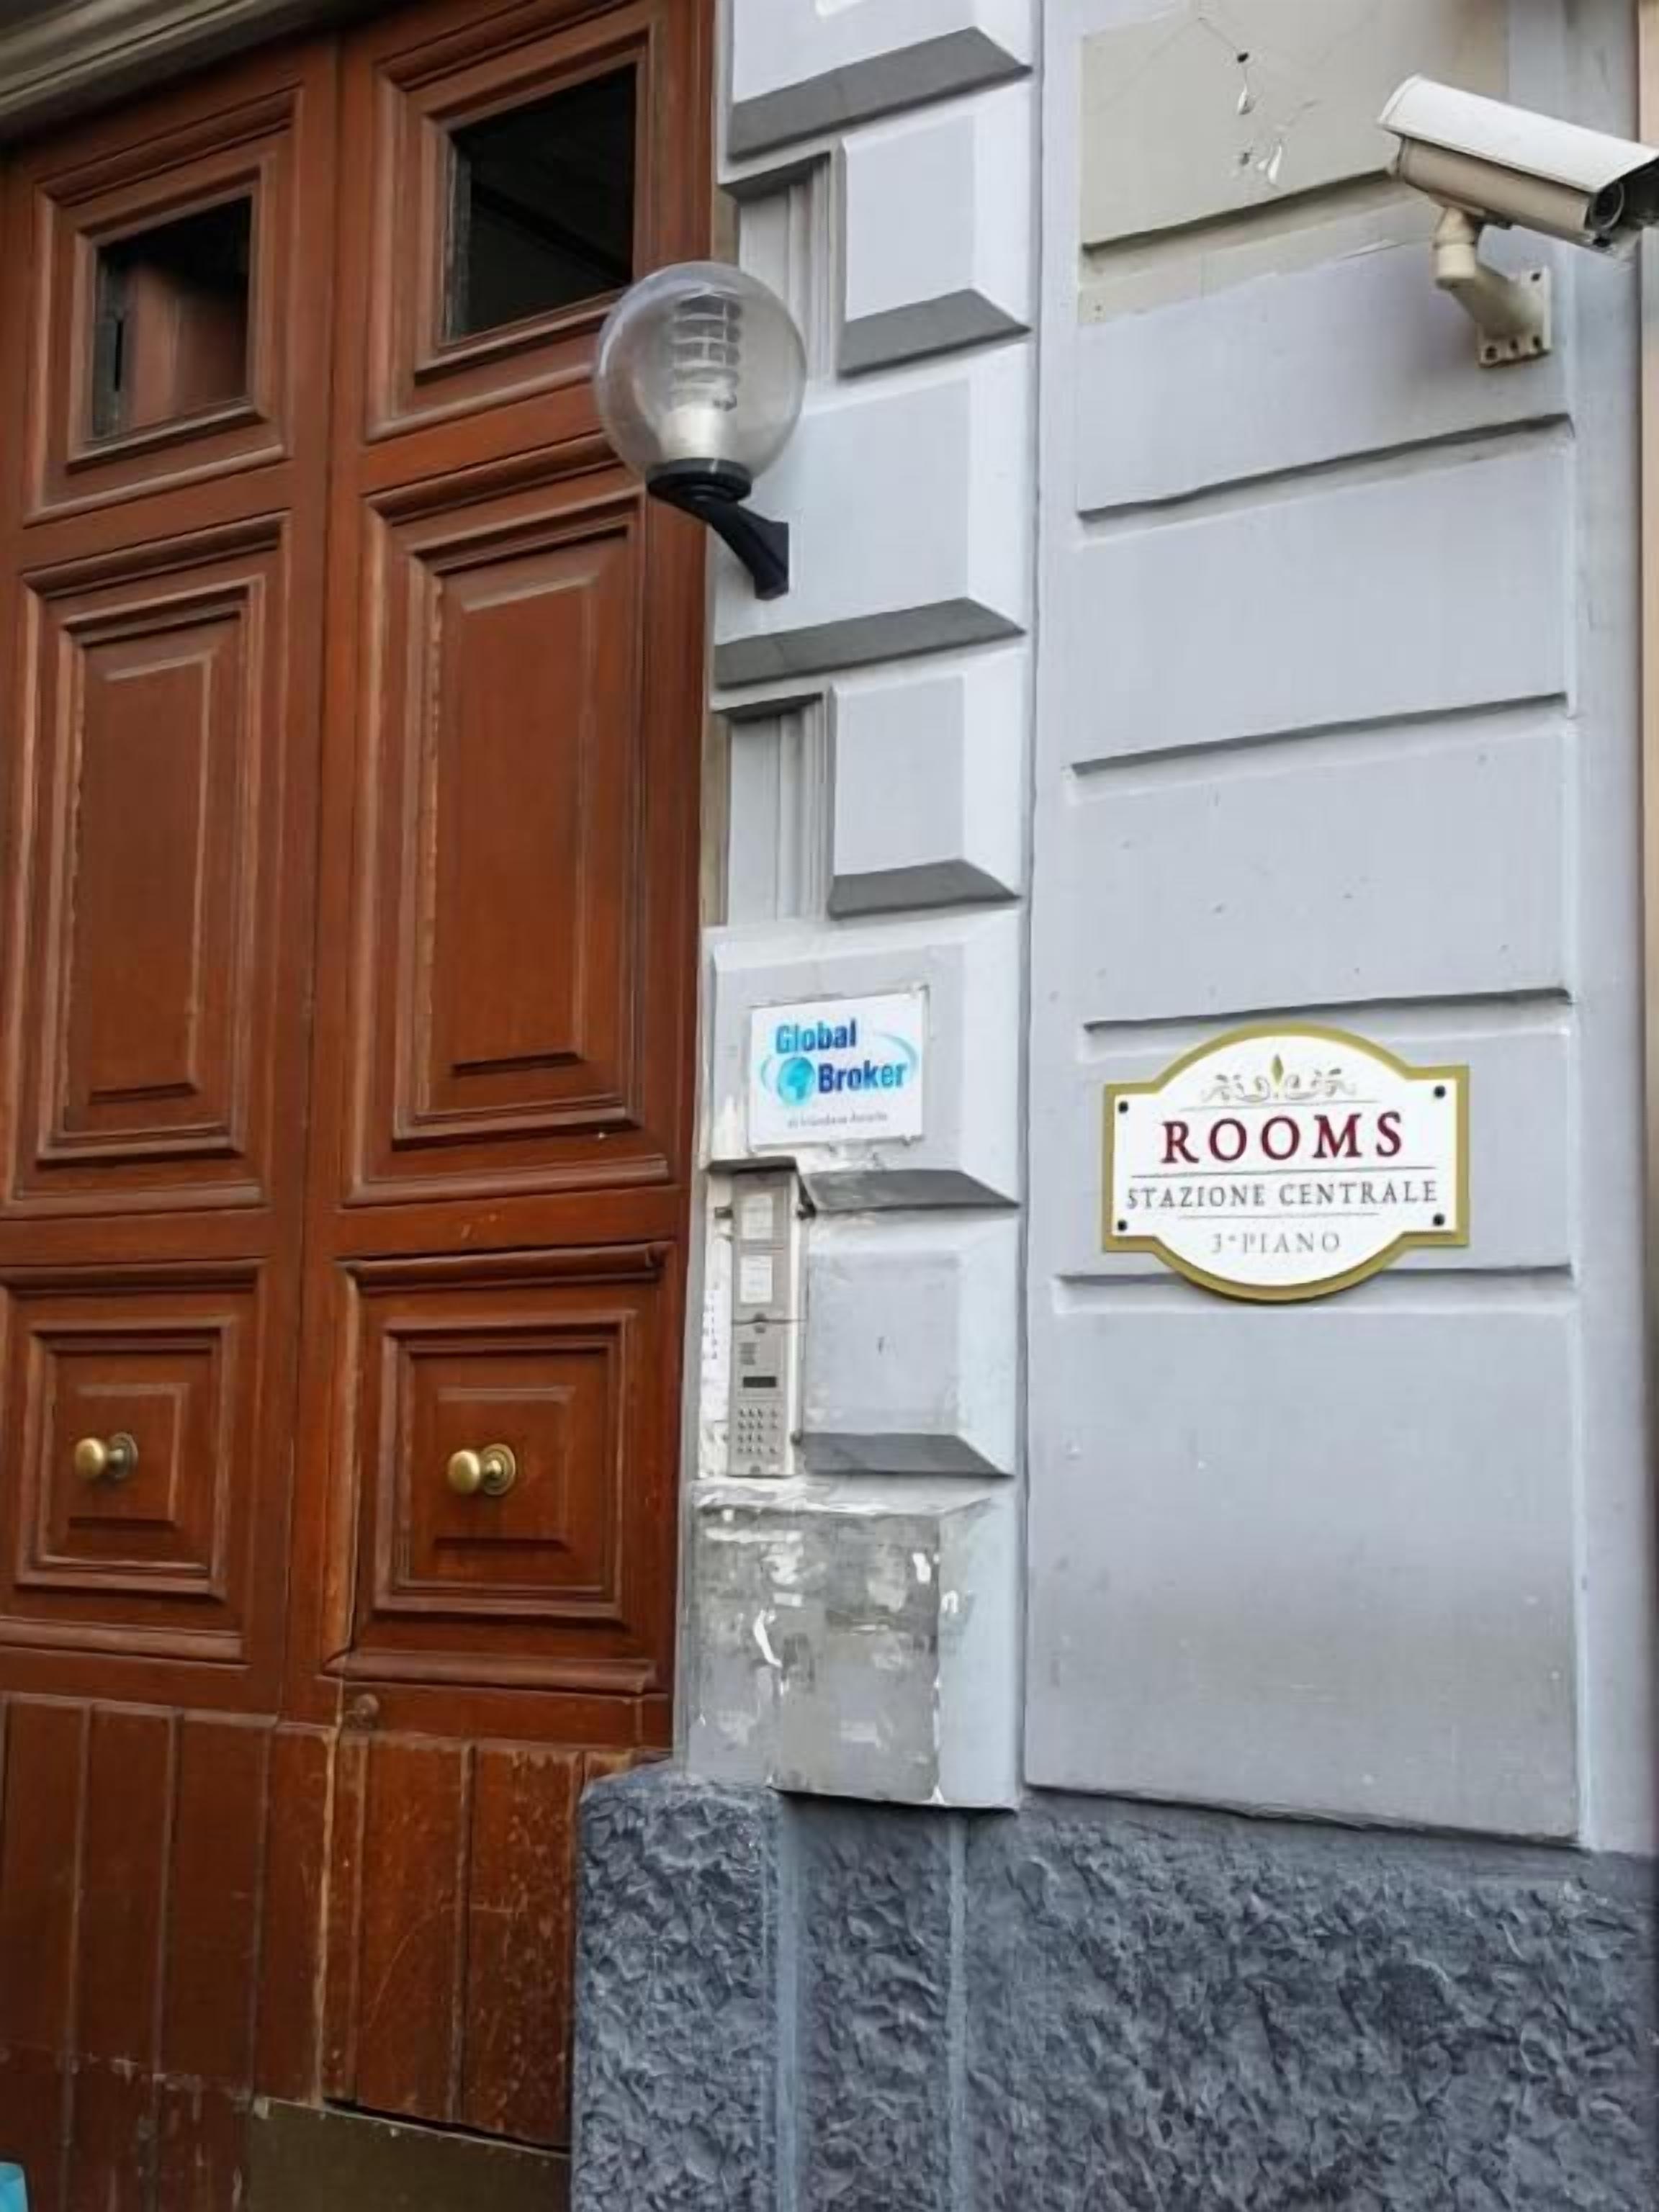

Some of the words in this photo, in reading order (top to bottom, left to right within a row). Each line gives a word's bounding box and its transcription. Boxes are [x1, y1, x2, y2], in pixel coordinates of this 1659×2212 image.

[775, 1017, 856, 1053] Global
[818, 1059, 907, 1093] Broker
[1160, 1110, 1403, 1164] ROOMS
[1127, 1183, 1266, 1210] STAZIONE
[1279, 1179, 1438, 1206] CENTRALE
[1243, 1231, 1341, 1254] PIANO
